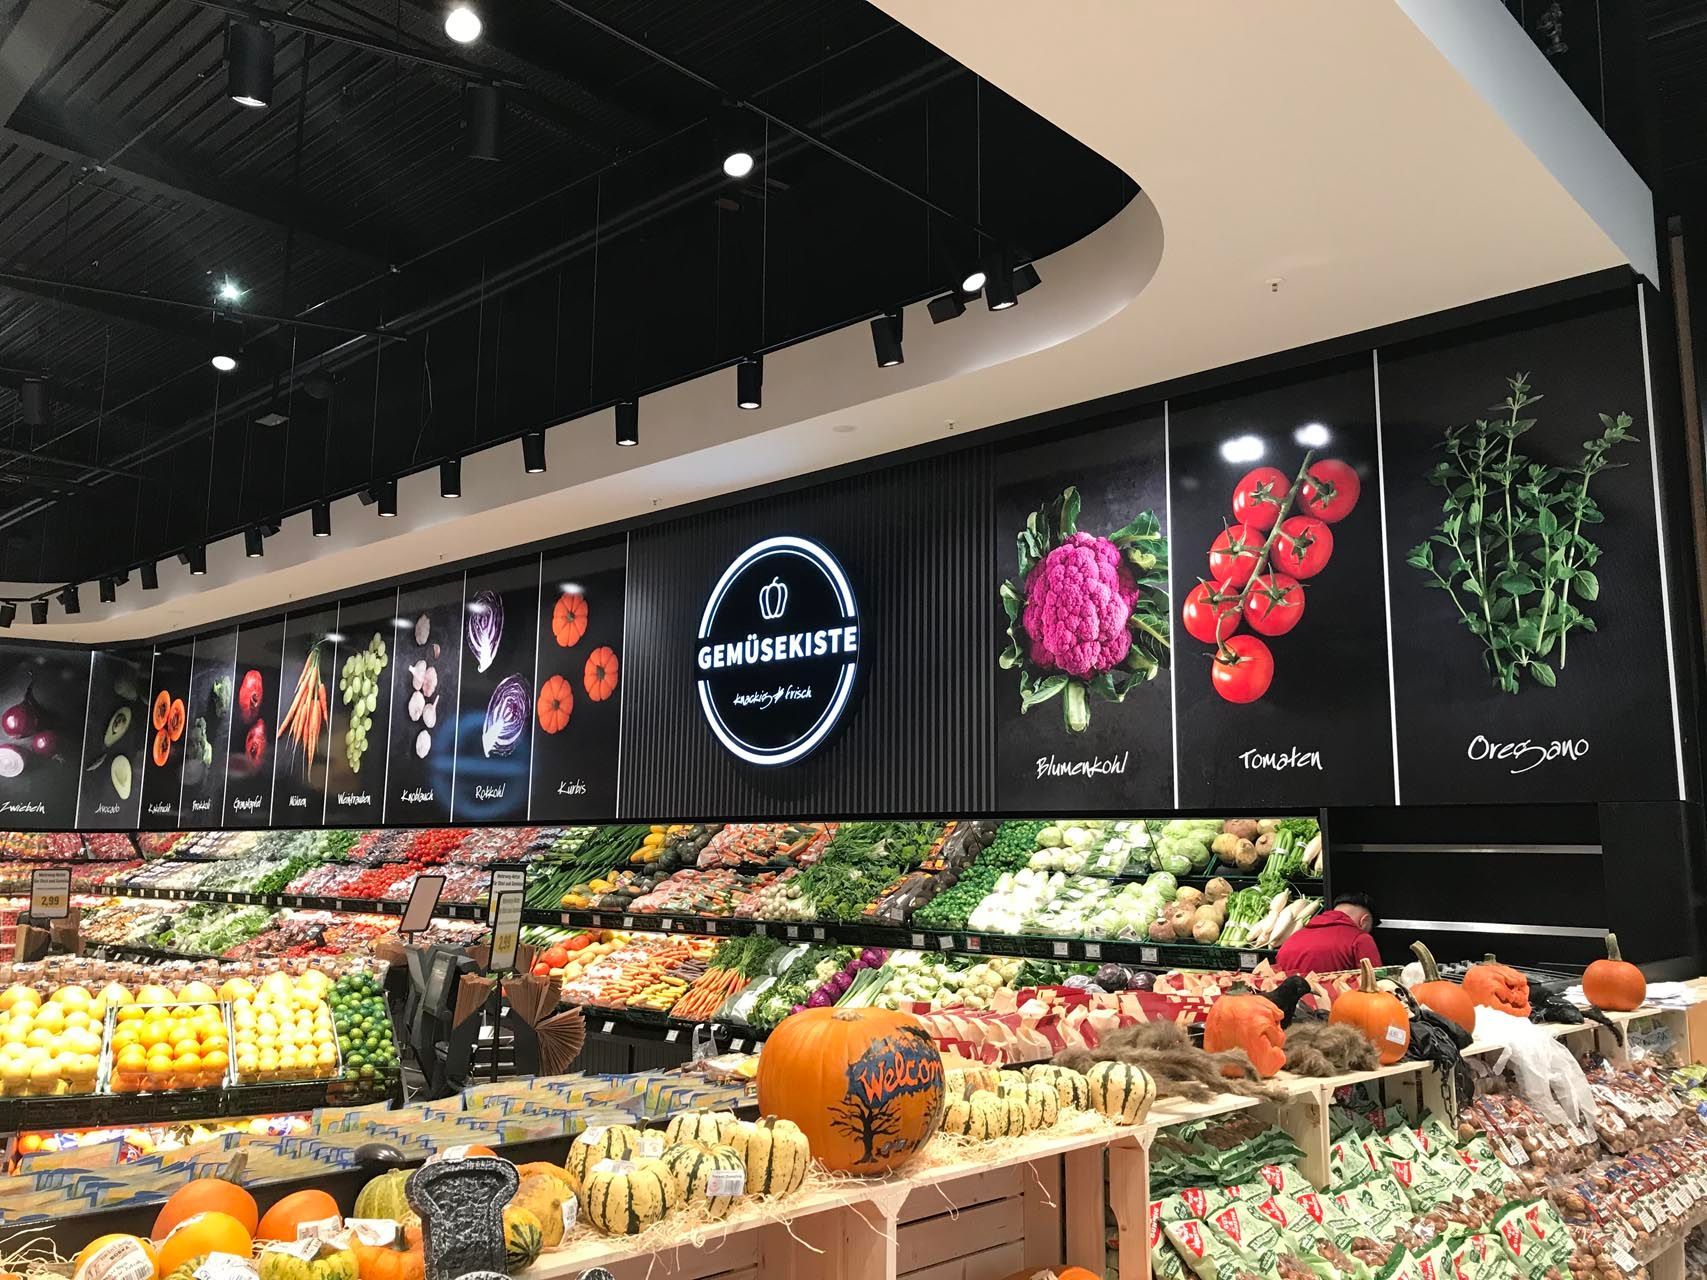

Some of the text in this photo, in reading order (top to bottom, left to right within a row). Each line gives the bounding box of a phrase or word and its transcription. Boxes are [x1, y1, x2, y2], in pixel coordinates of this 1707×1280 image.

[697, 626, 858, 670] GEMÜSEKISTE
[733, 684, 812, 710] knackig frisch
[1238, 746, 1323, 772] Tomaten
[1466, 733, 1590, 774] Oregano
[1036, 751, 1129, 779] Blumenkohl
[401, 787, 434, 803] Knoblauch
[475, 783, 506, 800] Rotkohl
[557, 779, 587, 796] Kürbis
[0, 801, 45, 814] Zwiebeln
[95, 803, 121, 814] Avocado
[41, 895, 60, 907] 2,99
